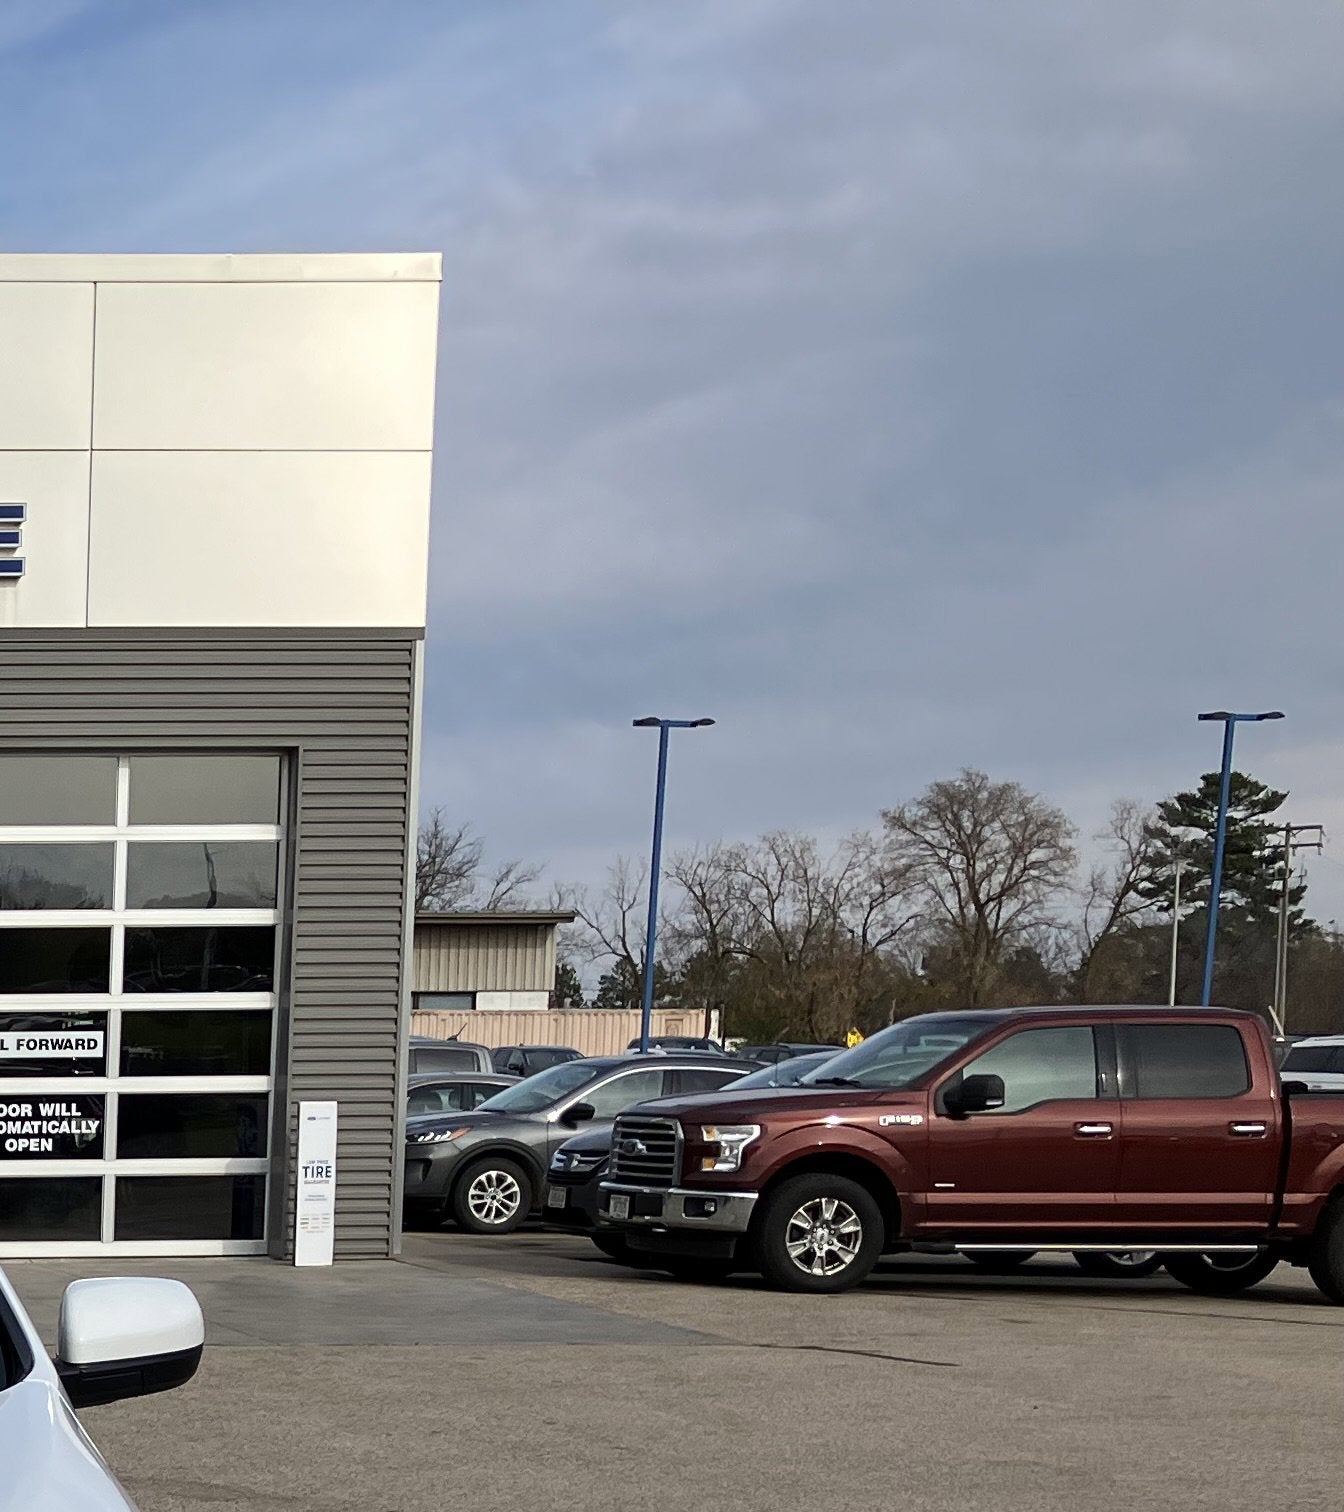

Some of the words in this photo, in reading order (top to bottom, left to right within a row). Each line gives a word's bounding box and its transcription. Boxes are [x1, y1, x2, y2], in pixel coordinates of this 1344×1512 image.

[15, 1037, 99, 1051] FORWARD
[38, 1102, 82, 1117] WILL
[4, 1137, 54, 1152] OPEN
[301, 1165, 333, 1179] TIRE
